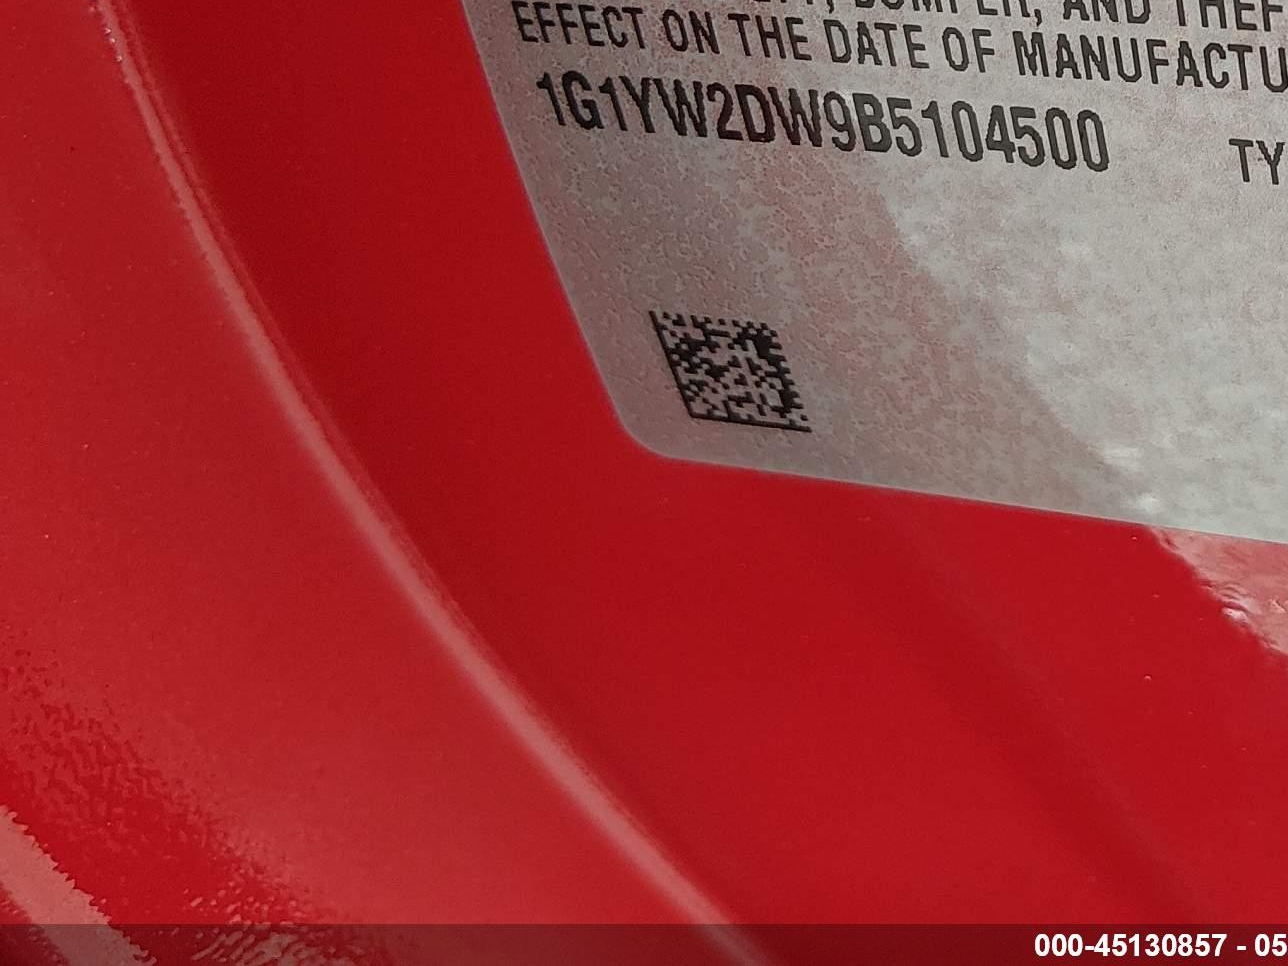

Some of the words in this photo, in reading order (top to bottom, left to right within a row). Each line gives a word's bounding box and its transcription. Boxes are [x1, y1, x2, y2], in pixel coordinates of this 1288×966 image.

[511, 0, 646, 50] EFFECT
[662, 8, 721, 57] ON
[728, 13, 812, 62] THE
[823, 19, 931, 69] DATE
[942, 26, 997, 74] OF
[536, 70, 1110, 172] 1G1YW2DW9B5104500
